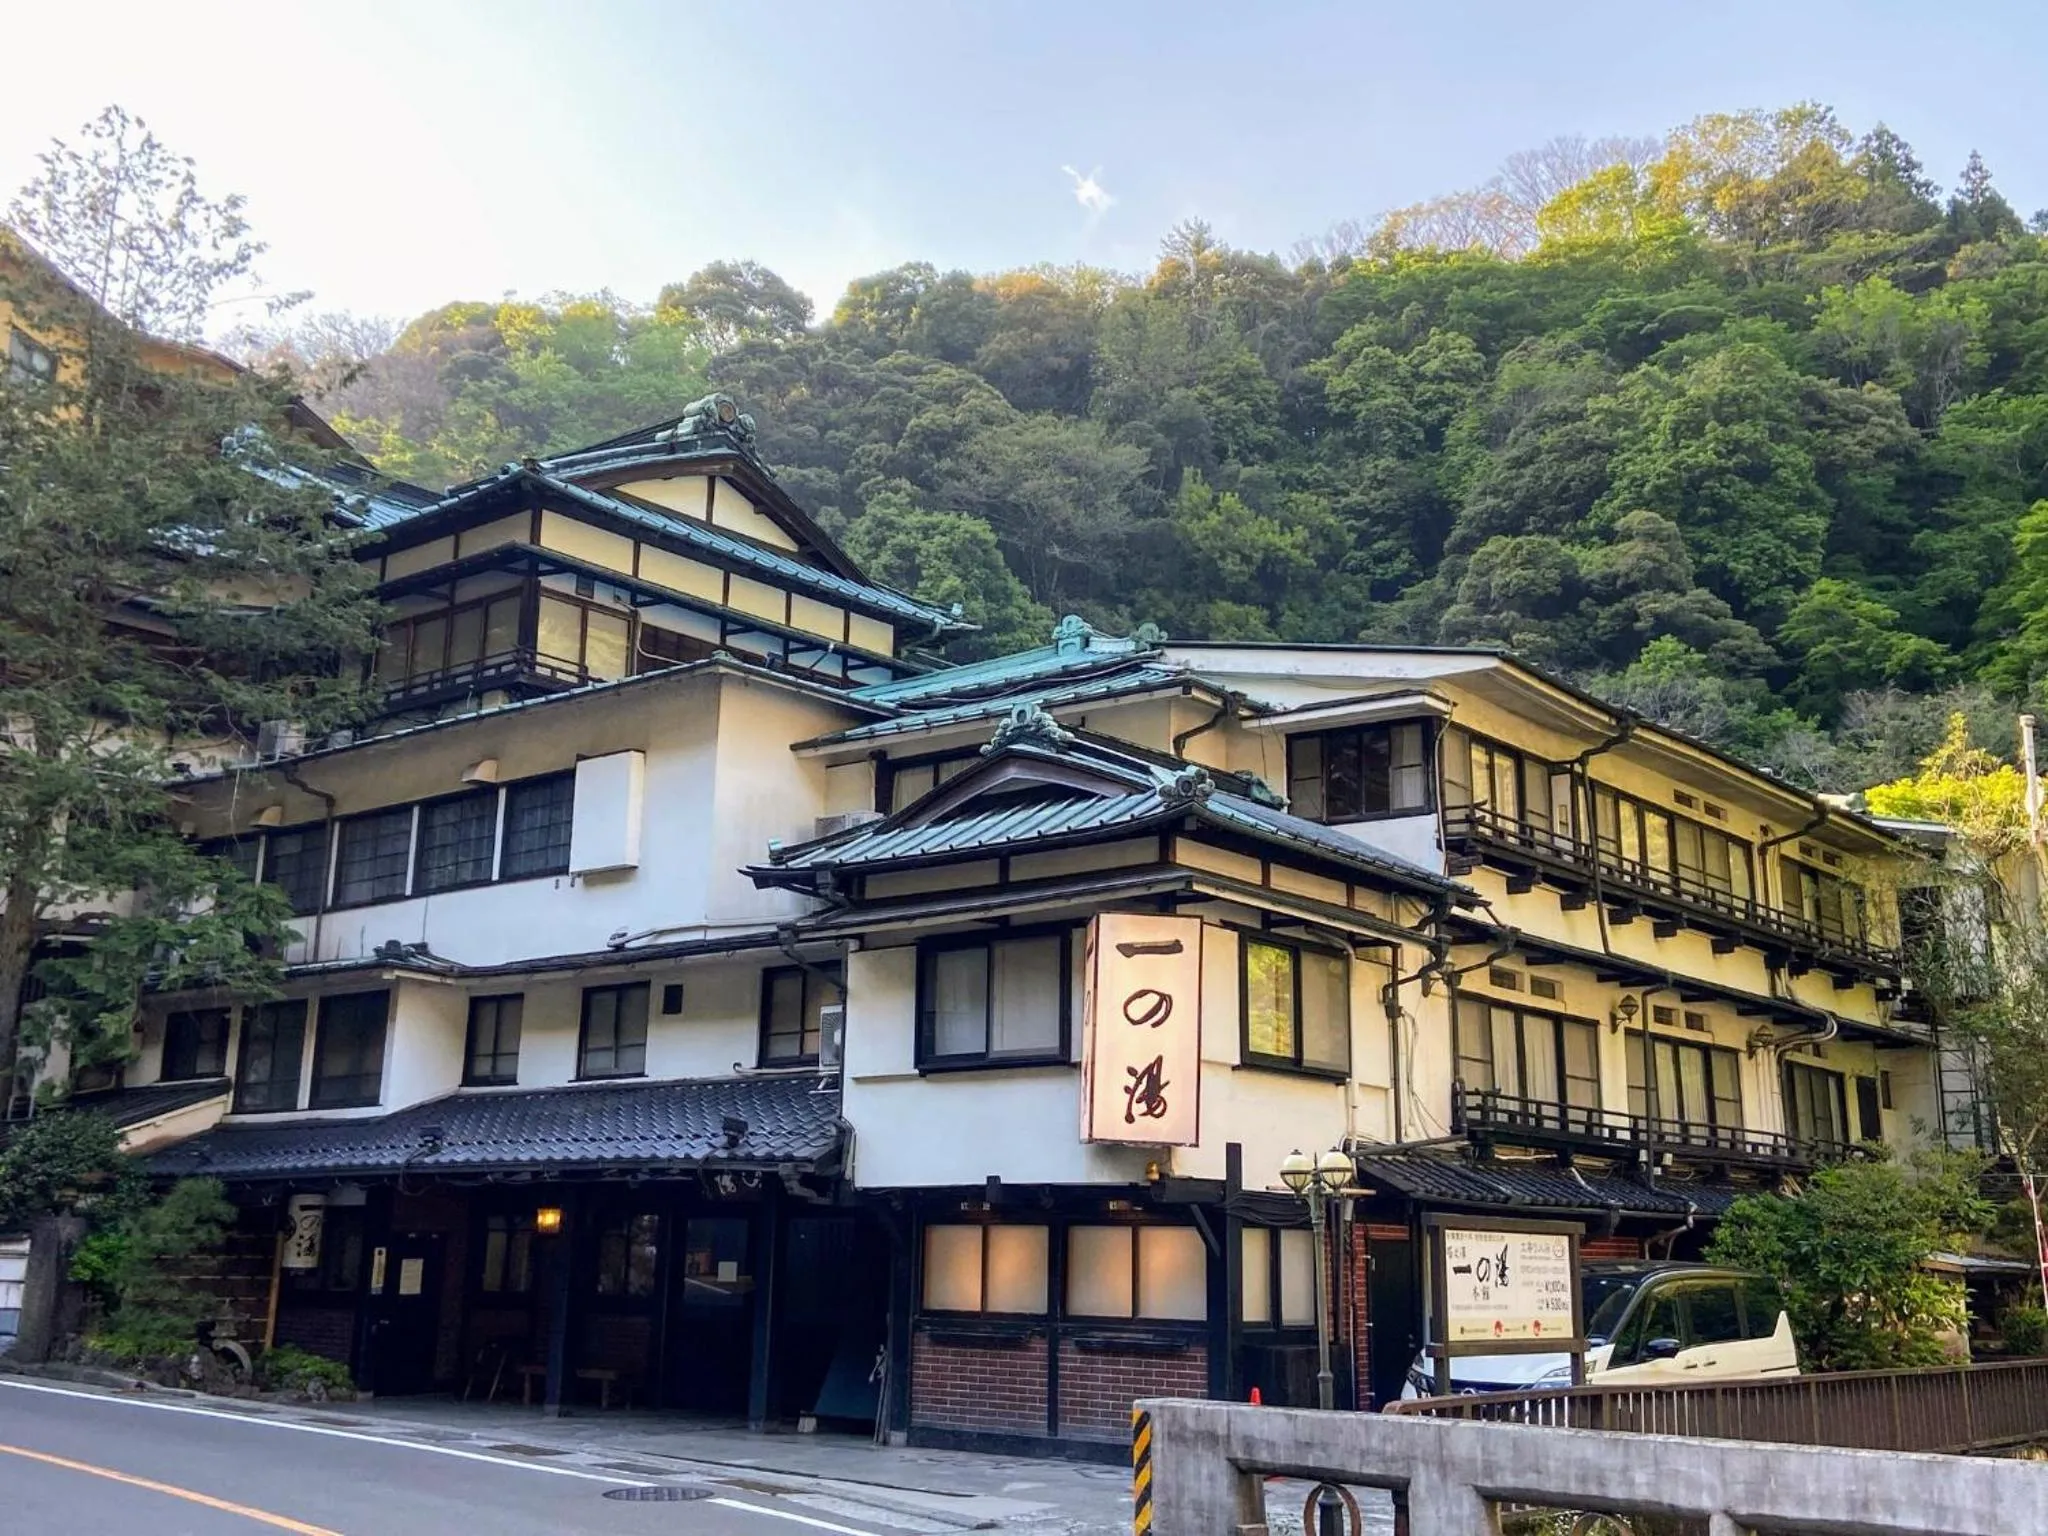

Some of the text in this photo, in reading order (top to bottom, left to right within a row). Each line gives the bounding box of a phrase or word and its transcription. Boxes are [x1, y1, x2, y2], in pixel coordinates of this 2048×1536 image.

[1115, 938, 1184, 1125] 一の湯
[296, 1204, 322, 1257] 一の湯
[1452, 1243, 1510, 1288] 一の湯
